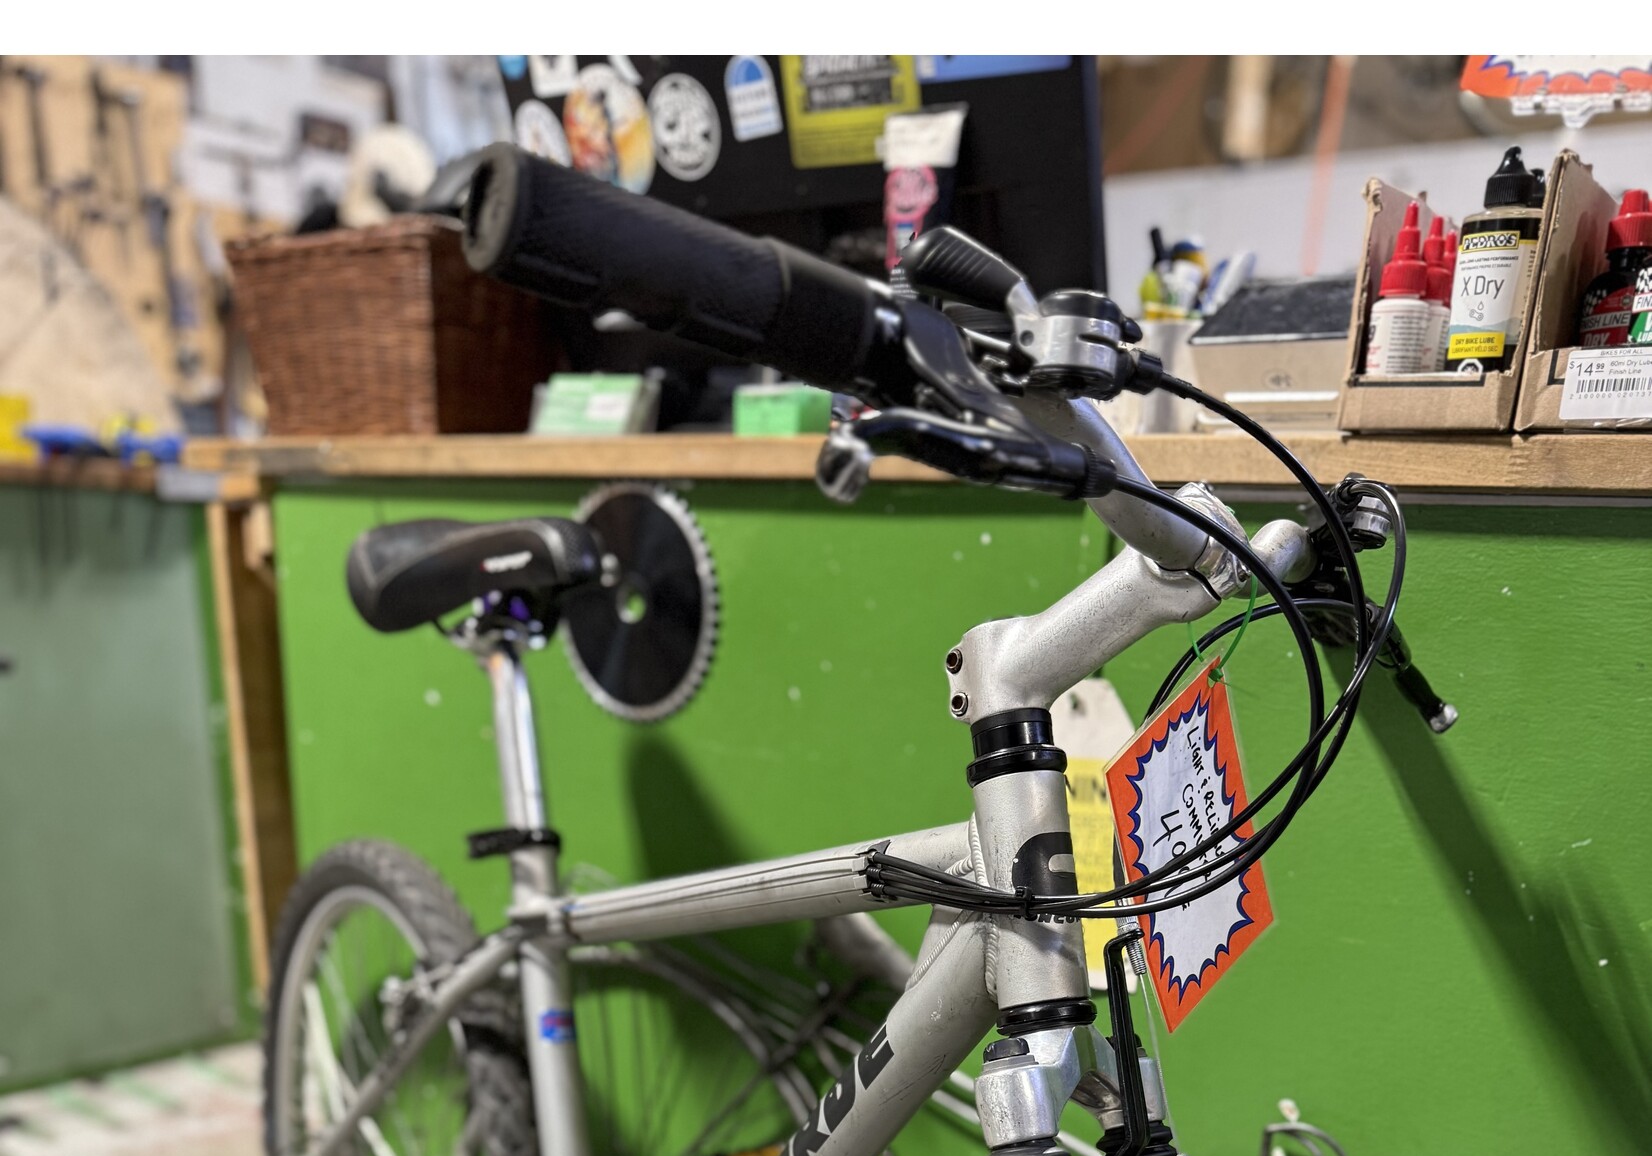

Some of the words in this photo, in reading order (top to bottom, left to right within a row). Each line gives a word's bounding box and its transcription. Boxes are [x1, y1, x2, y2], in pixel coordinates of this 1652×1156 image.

[1461, 276, 1471, 297] X
[1474, 275, 1505, 300] Dry
[1603, 311, 1631, 325] LINE
[1479, 336, 1496, 344] LUBE
[1626, 359, 1639, 367] Dry
